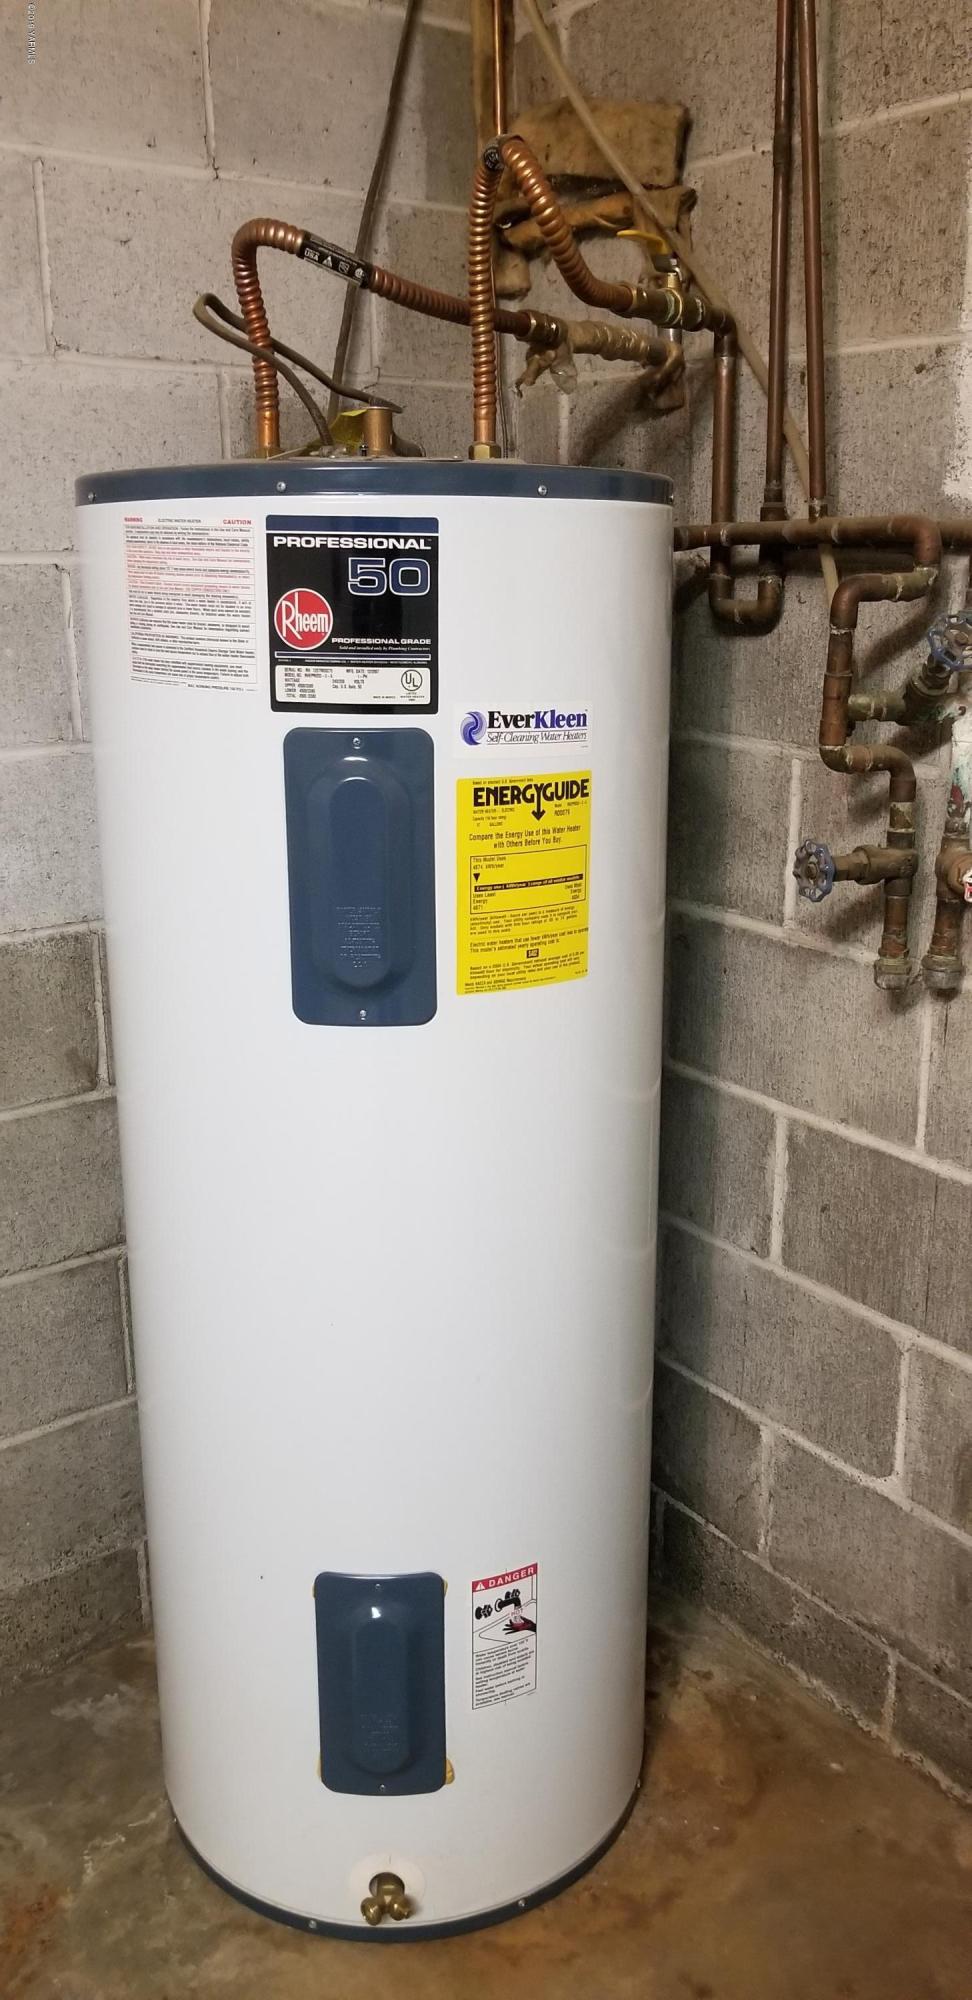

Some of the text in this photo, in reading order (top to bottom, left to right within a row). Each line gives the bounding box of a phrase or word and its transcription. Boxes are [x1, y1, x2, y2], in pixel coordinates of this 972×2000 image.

[273, 536, 431, 550] PROFESSIONAL
[348, 557, 430, 596] 50
[281, 591, 329, 640] Rheem
[405, 672, 419, 687] UL
[488, 709, 587, 729] EverKleen
[487, 732, 587, 744] Self-Cleaning Water Heaters
[473, 778, 589, 808] ENERGYGUIDE
[505, 831, 523, 839] Energy
[506, 840, 522, 848] Others
[488, 1566, 535, 1588] DANGER
